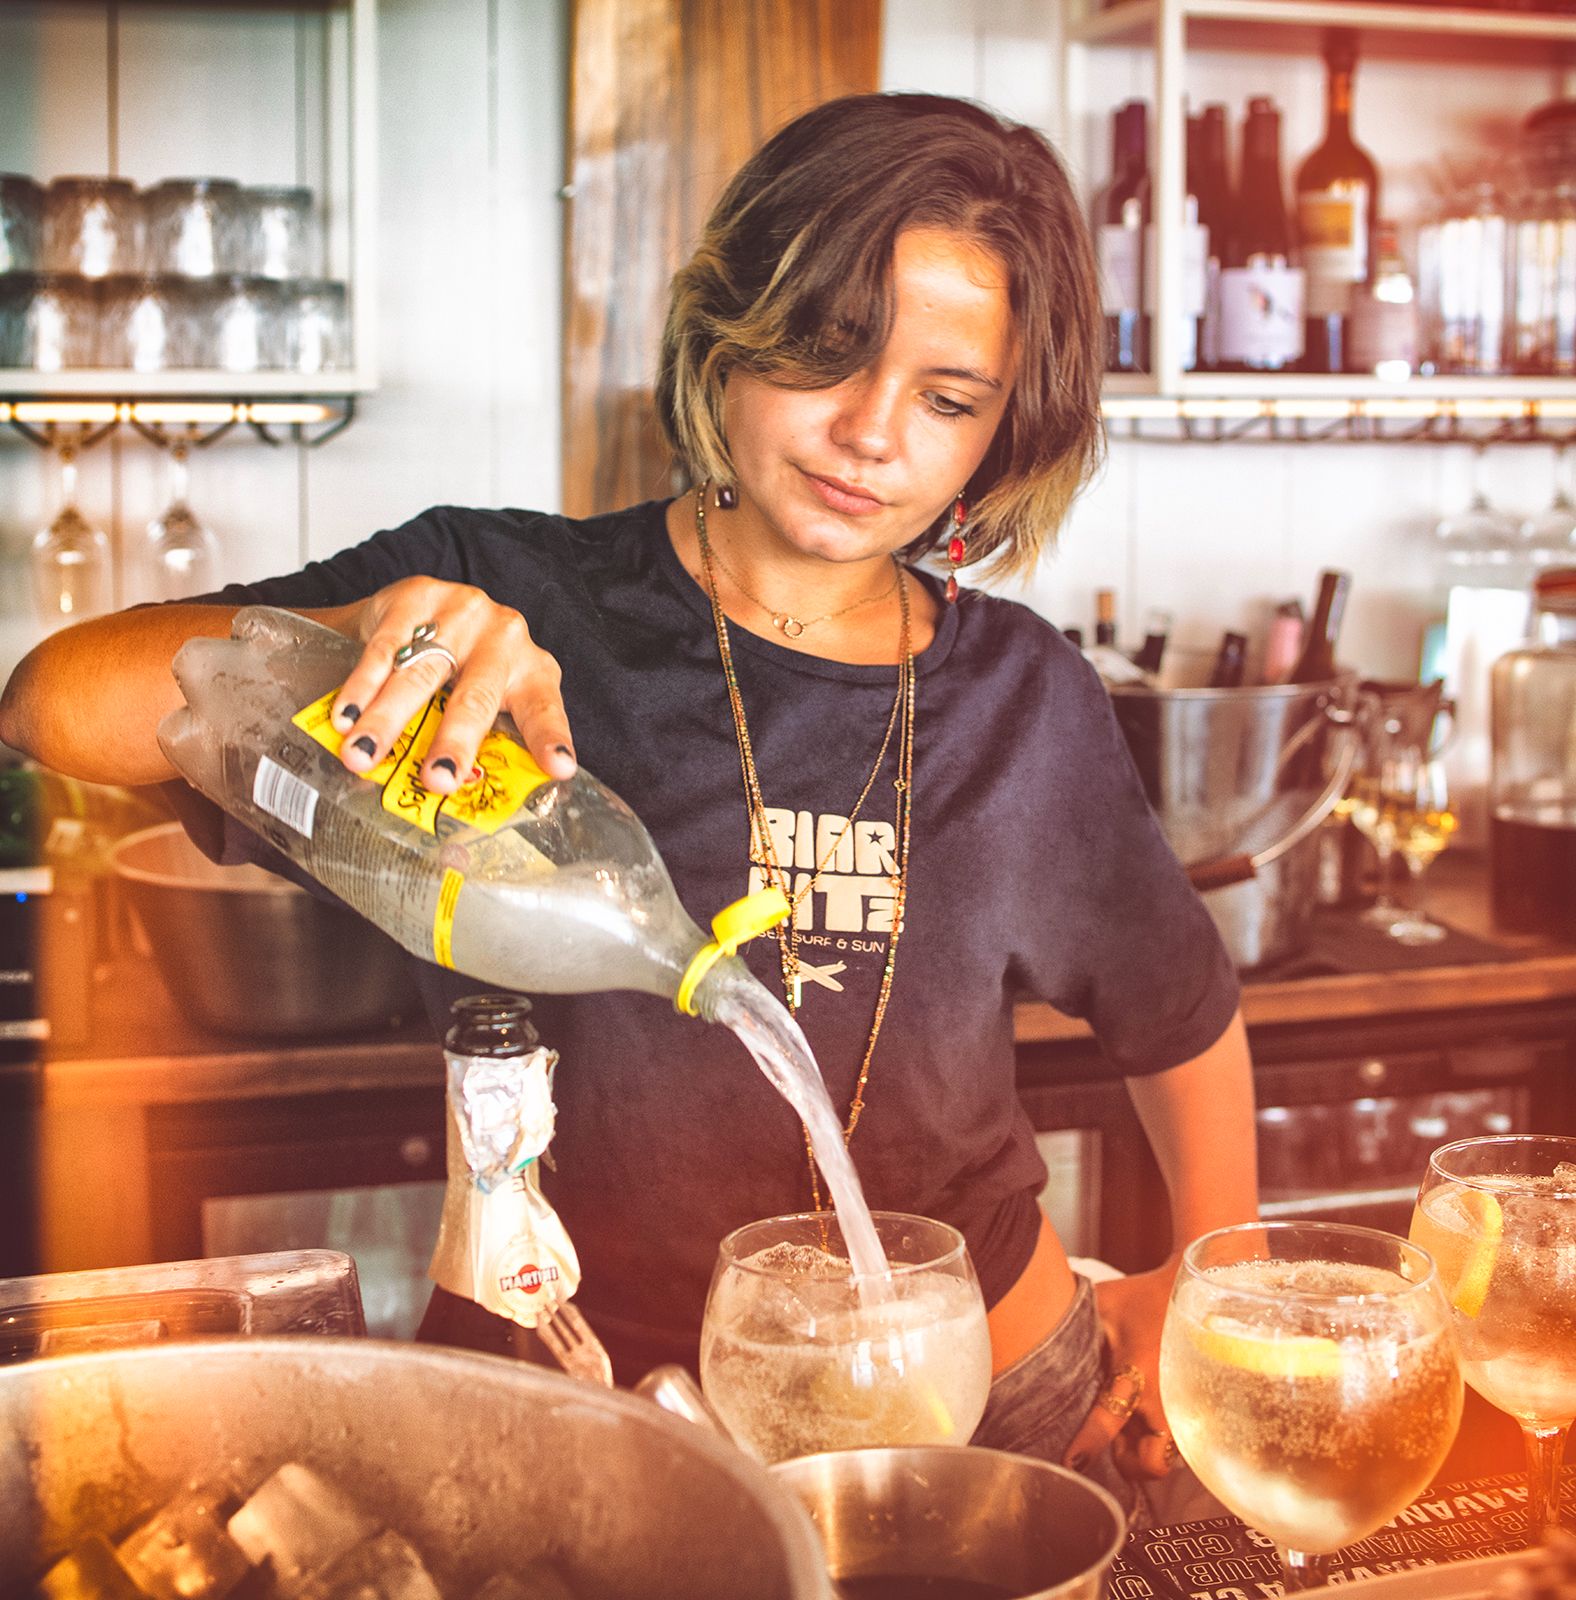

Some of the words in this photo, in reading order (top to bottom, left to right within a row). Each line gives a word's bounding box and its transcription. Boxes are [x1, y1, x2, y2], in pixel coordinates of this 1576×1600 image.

[794, 934, 832, 947] SURF
[837, 938, 848, 950] &
[851, 939, 886, 954] SUN
